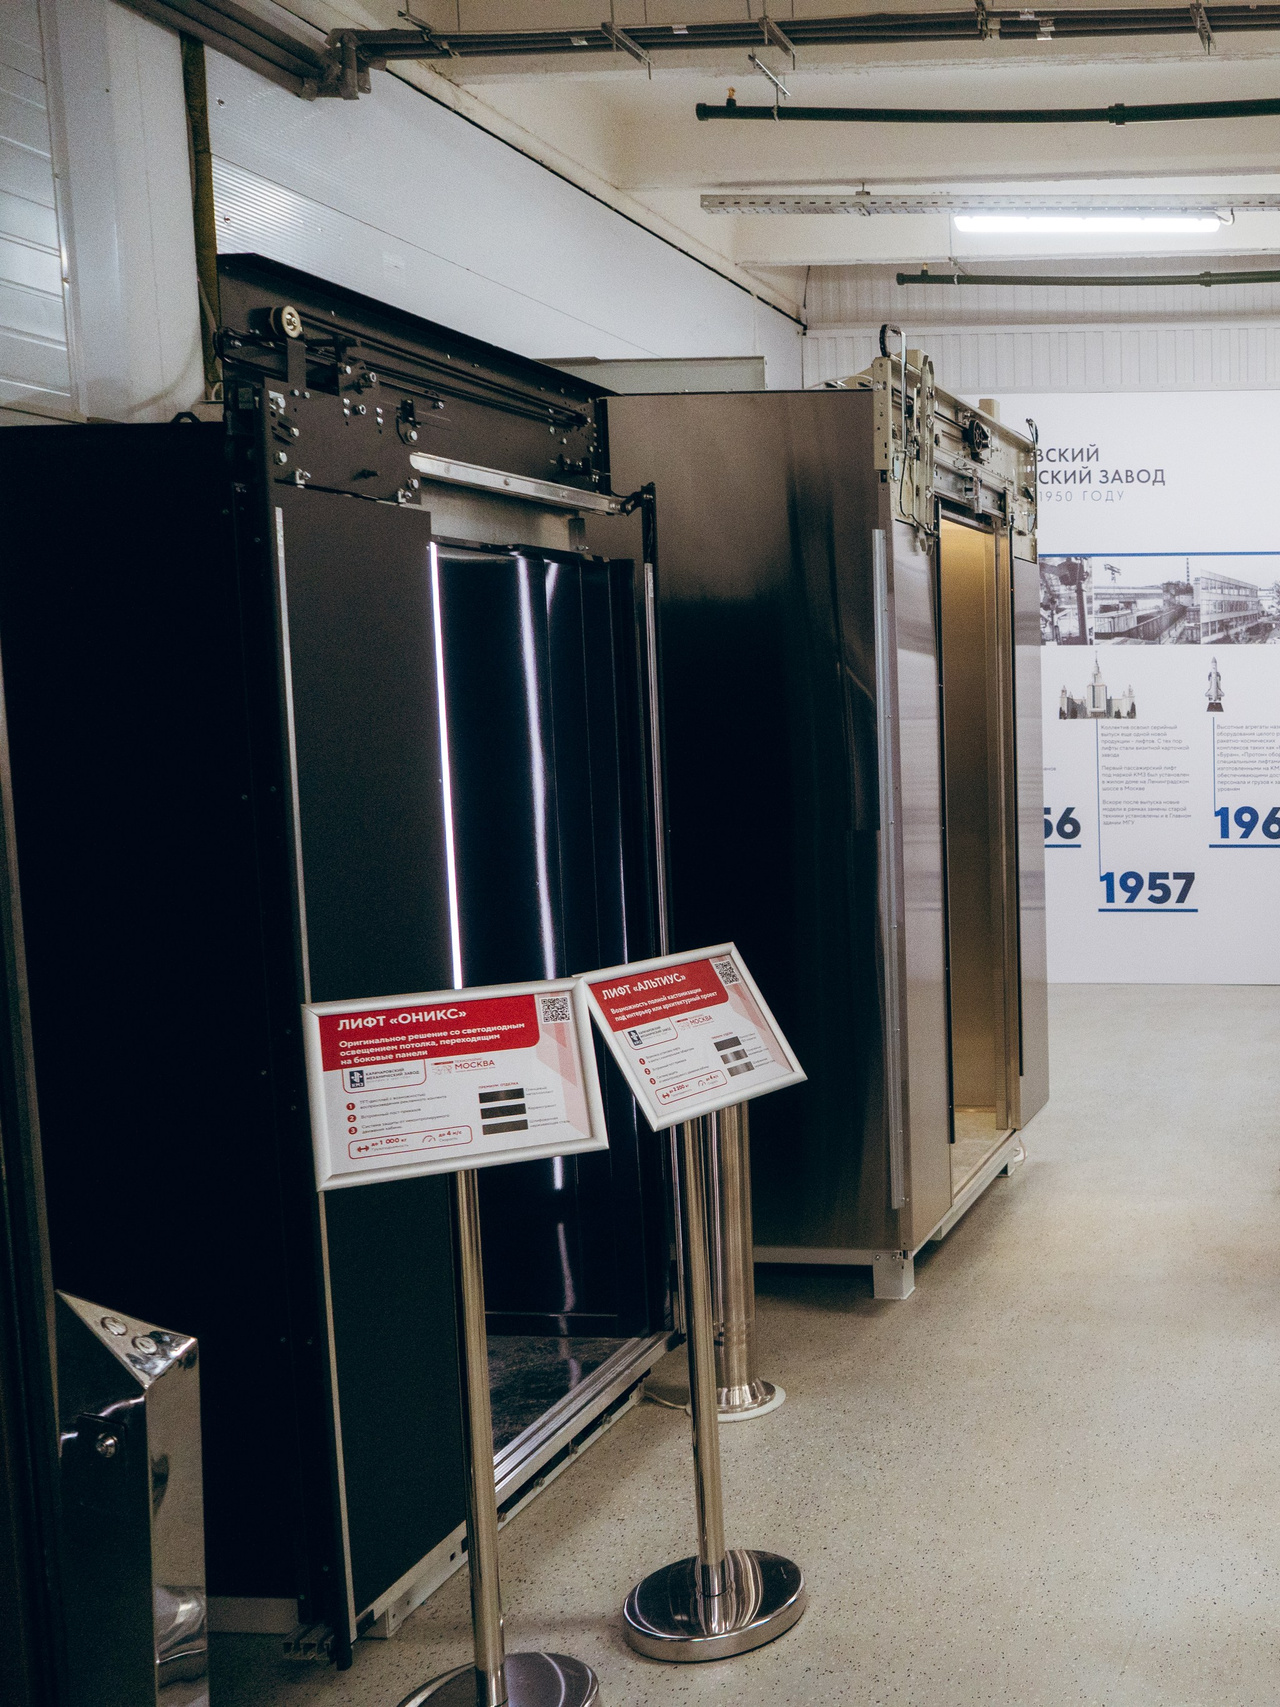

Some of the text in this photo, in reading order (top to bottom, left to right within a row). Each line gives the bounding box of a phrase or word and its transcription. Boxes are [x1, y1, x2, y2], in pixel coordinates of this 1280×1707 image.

[1036, 443, 1099, 462] ВСКИЙ
[1038, 465, 1166, 486] СКИЙ ЗАВОД
[1039, 490, 1124, 502] 1950 ГОДУ
[1100, 871, 1196, 904] 1957
[602, 973, 686, 1000] ЛИФТ «АЛЬТИУС»
[610, 1002, 648, 1014] Возможность
[648, 995, 668, 1006] полной
[627, 1009, 652, 1020] интерьер
[662, 995, 700, 1010] архитектурный
[701, 991, 718, 1000] проект
[337, 1008, 467, 1031] ЛИФТ «ОНИКС»
[690, 1015, 713, 1025] МОСКВА
[339, 1035, 406, 1048] Оригинальное
[408, 1031, 448, 1042] решение
[462, 1023, 525, 1034] светодиодным
[340, 1034, 500, 1057] освещением потолка, переходящим
[341, 1050, 428, 1066] на боковые панели
[455, 1060, 496, 1070] МОСКВА
